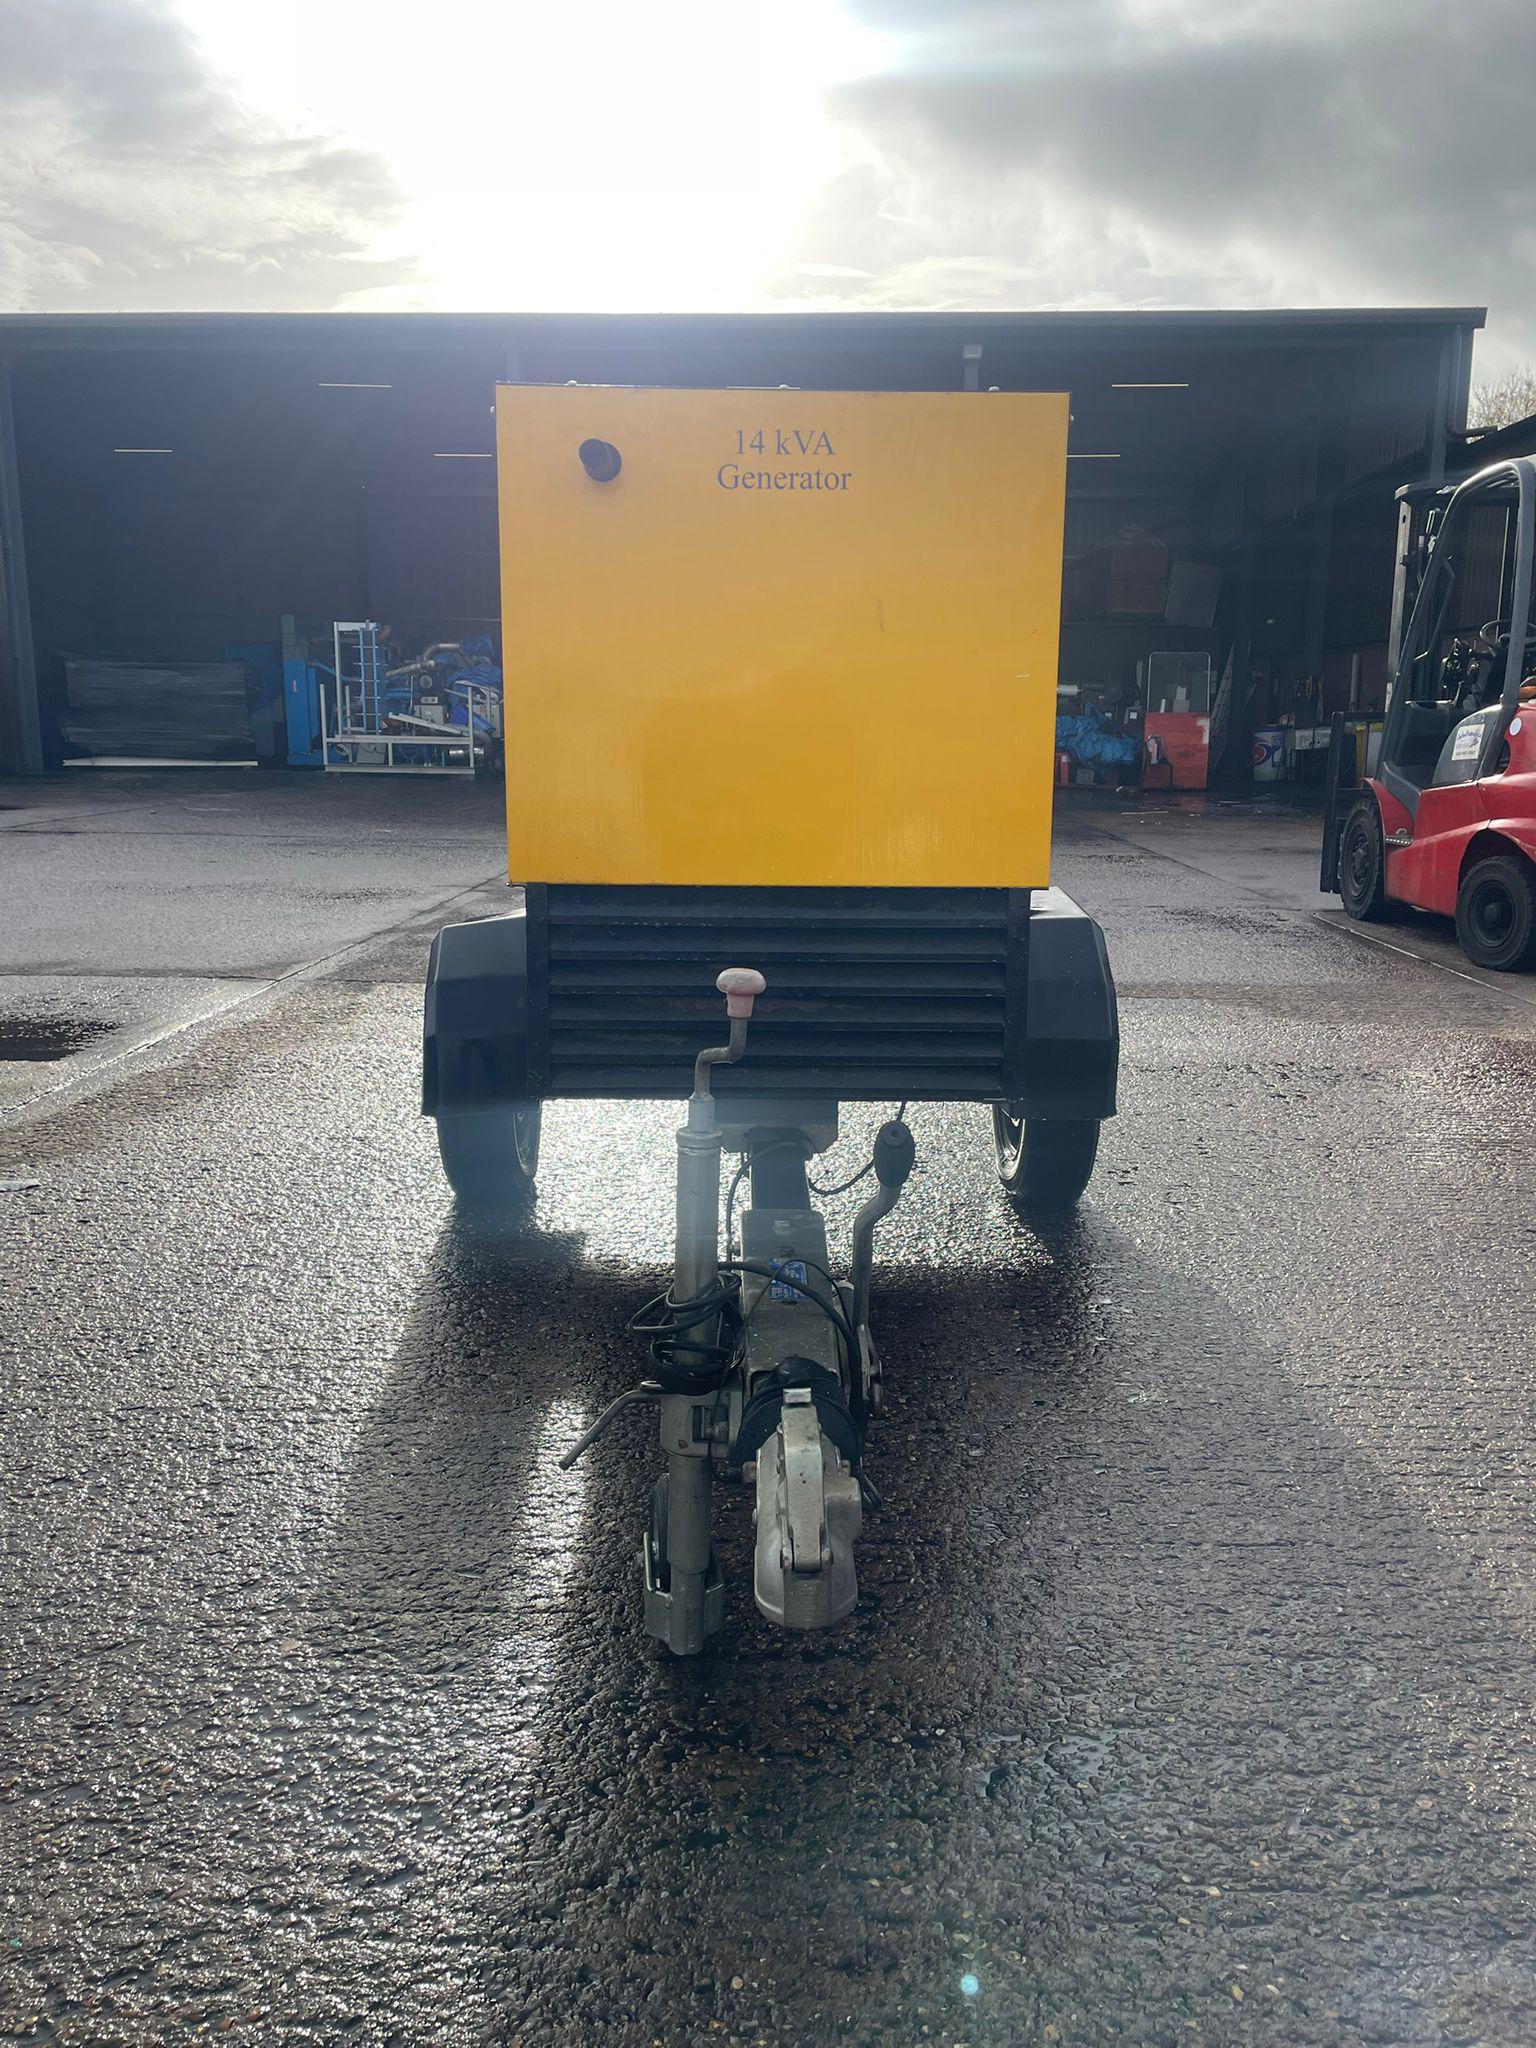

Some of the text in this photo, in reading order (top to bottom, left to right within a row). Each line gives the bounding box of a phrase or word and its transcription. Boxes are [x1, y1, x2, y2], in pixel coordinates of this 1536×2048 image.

[736, 429, 836, 456] 14 kVA
[717, 463, 853, 490] Generator
